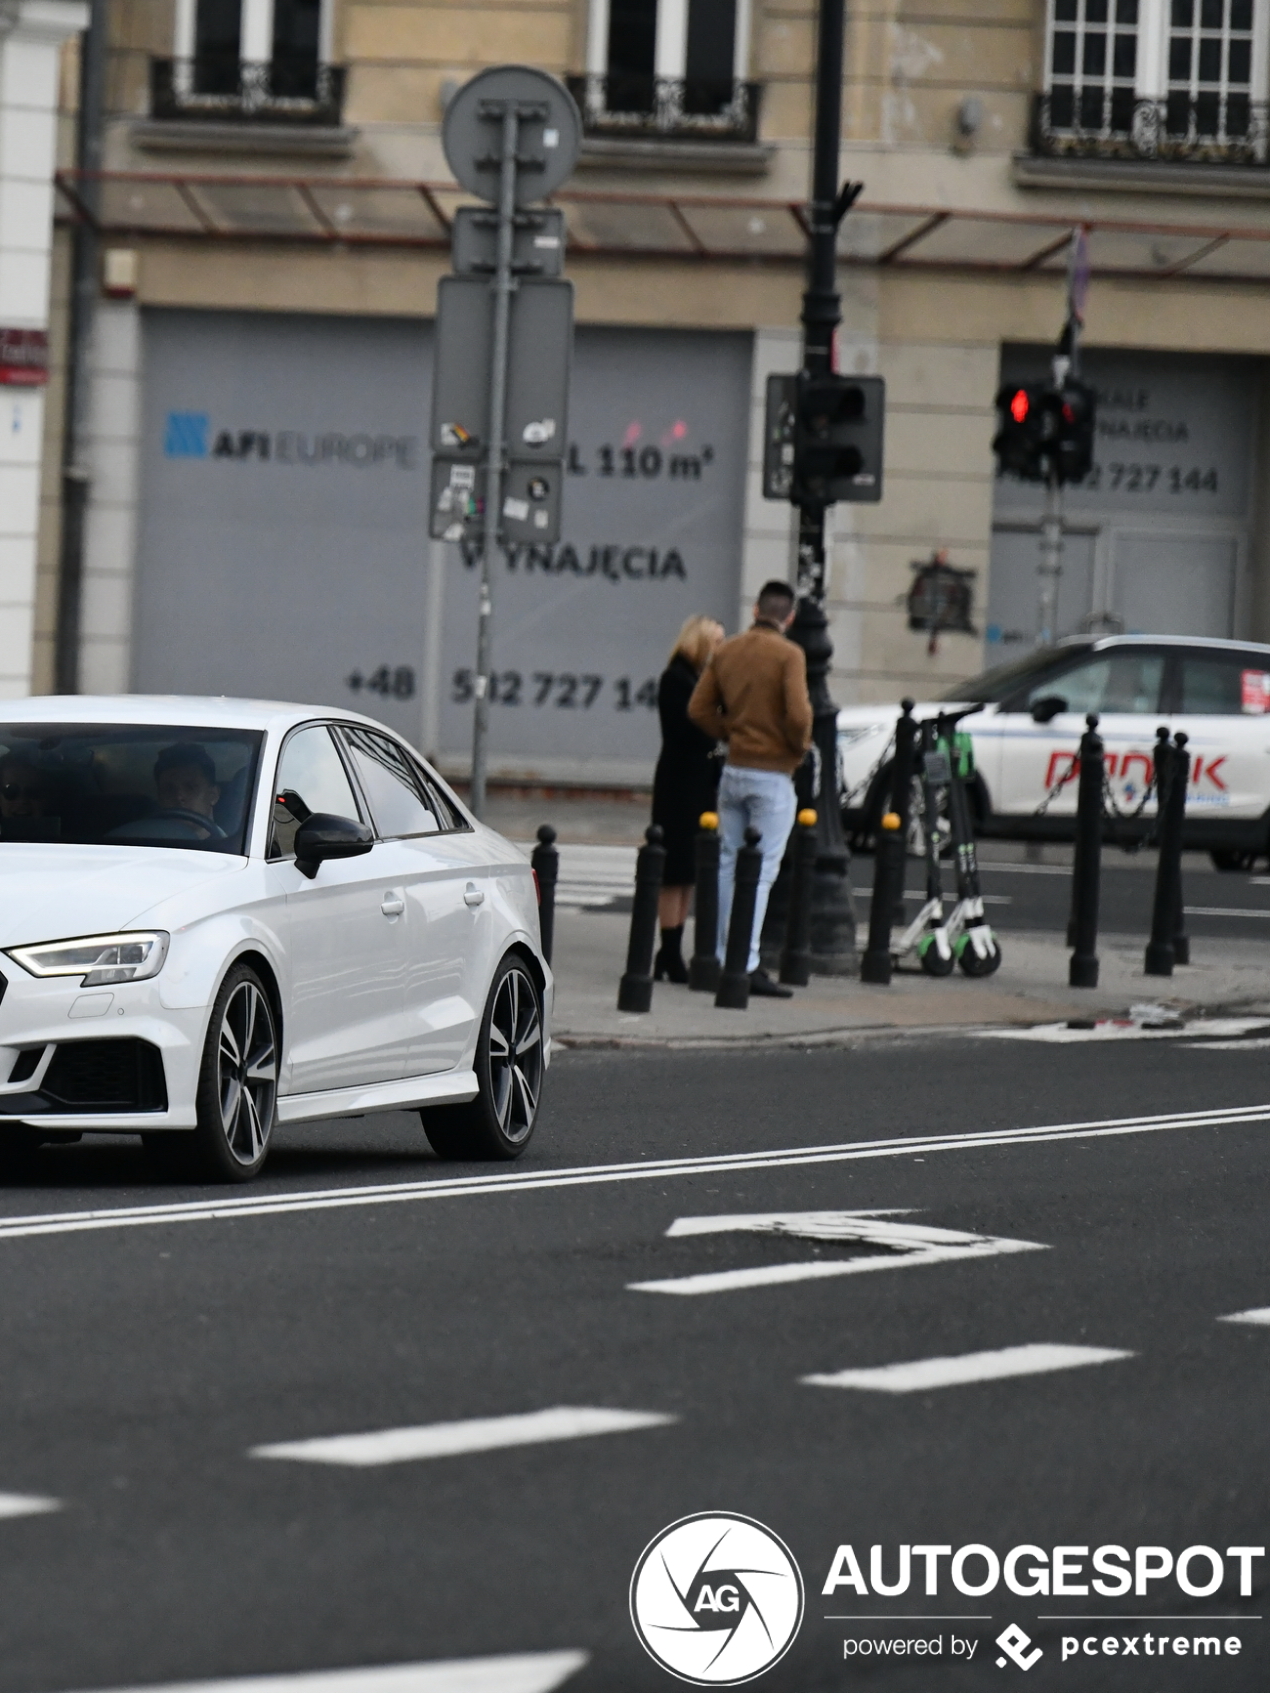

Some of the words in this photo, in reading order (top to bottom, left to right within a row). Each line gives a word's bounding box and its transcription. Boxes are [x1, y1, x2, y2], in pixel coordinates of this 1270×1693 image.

[214, 430, 270, 461] AFI
[276, 430, 417, 470] EUROPE
[599, 446, 662, 477] 110
[346, 664, 415, 700] +48
[533, 671, 603, 708] 727
